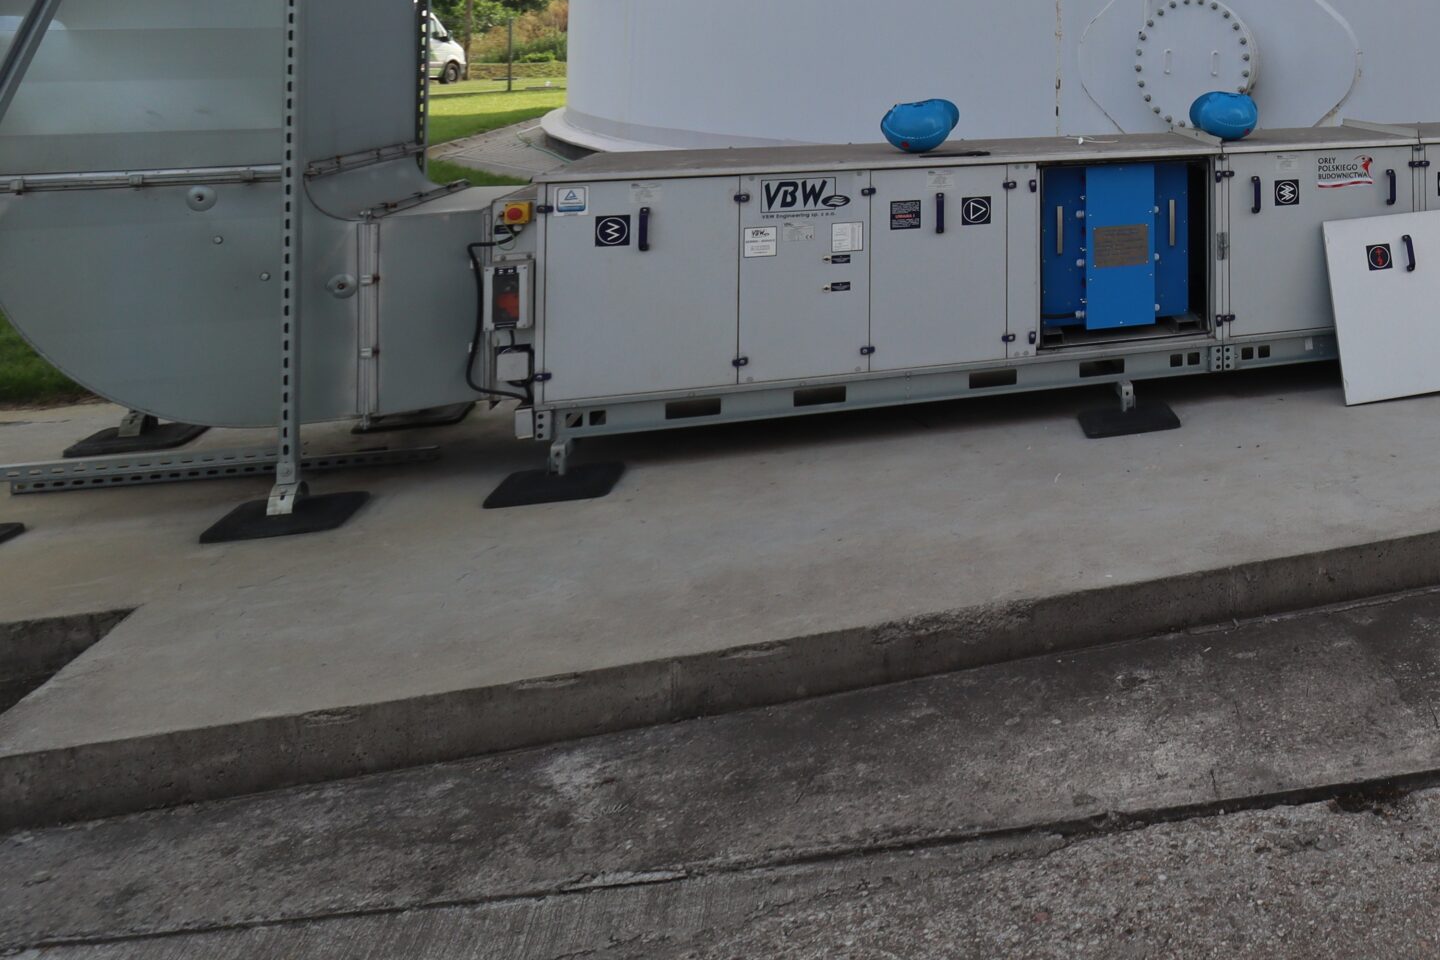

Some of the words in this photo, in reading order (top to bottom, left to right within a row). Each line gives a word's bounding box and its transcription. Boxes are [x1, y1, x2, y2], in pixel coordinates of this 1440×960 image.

[1318, 164, 1358, 172] POLSKIEGO
[1318, 172, 1368, 180] BUDOWNICTWA
[764, 179, 827, 211] VBW
